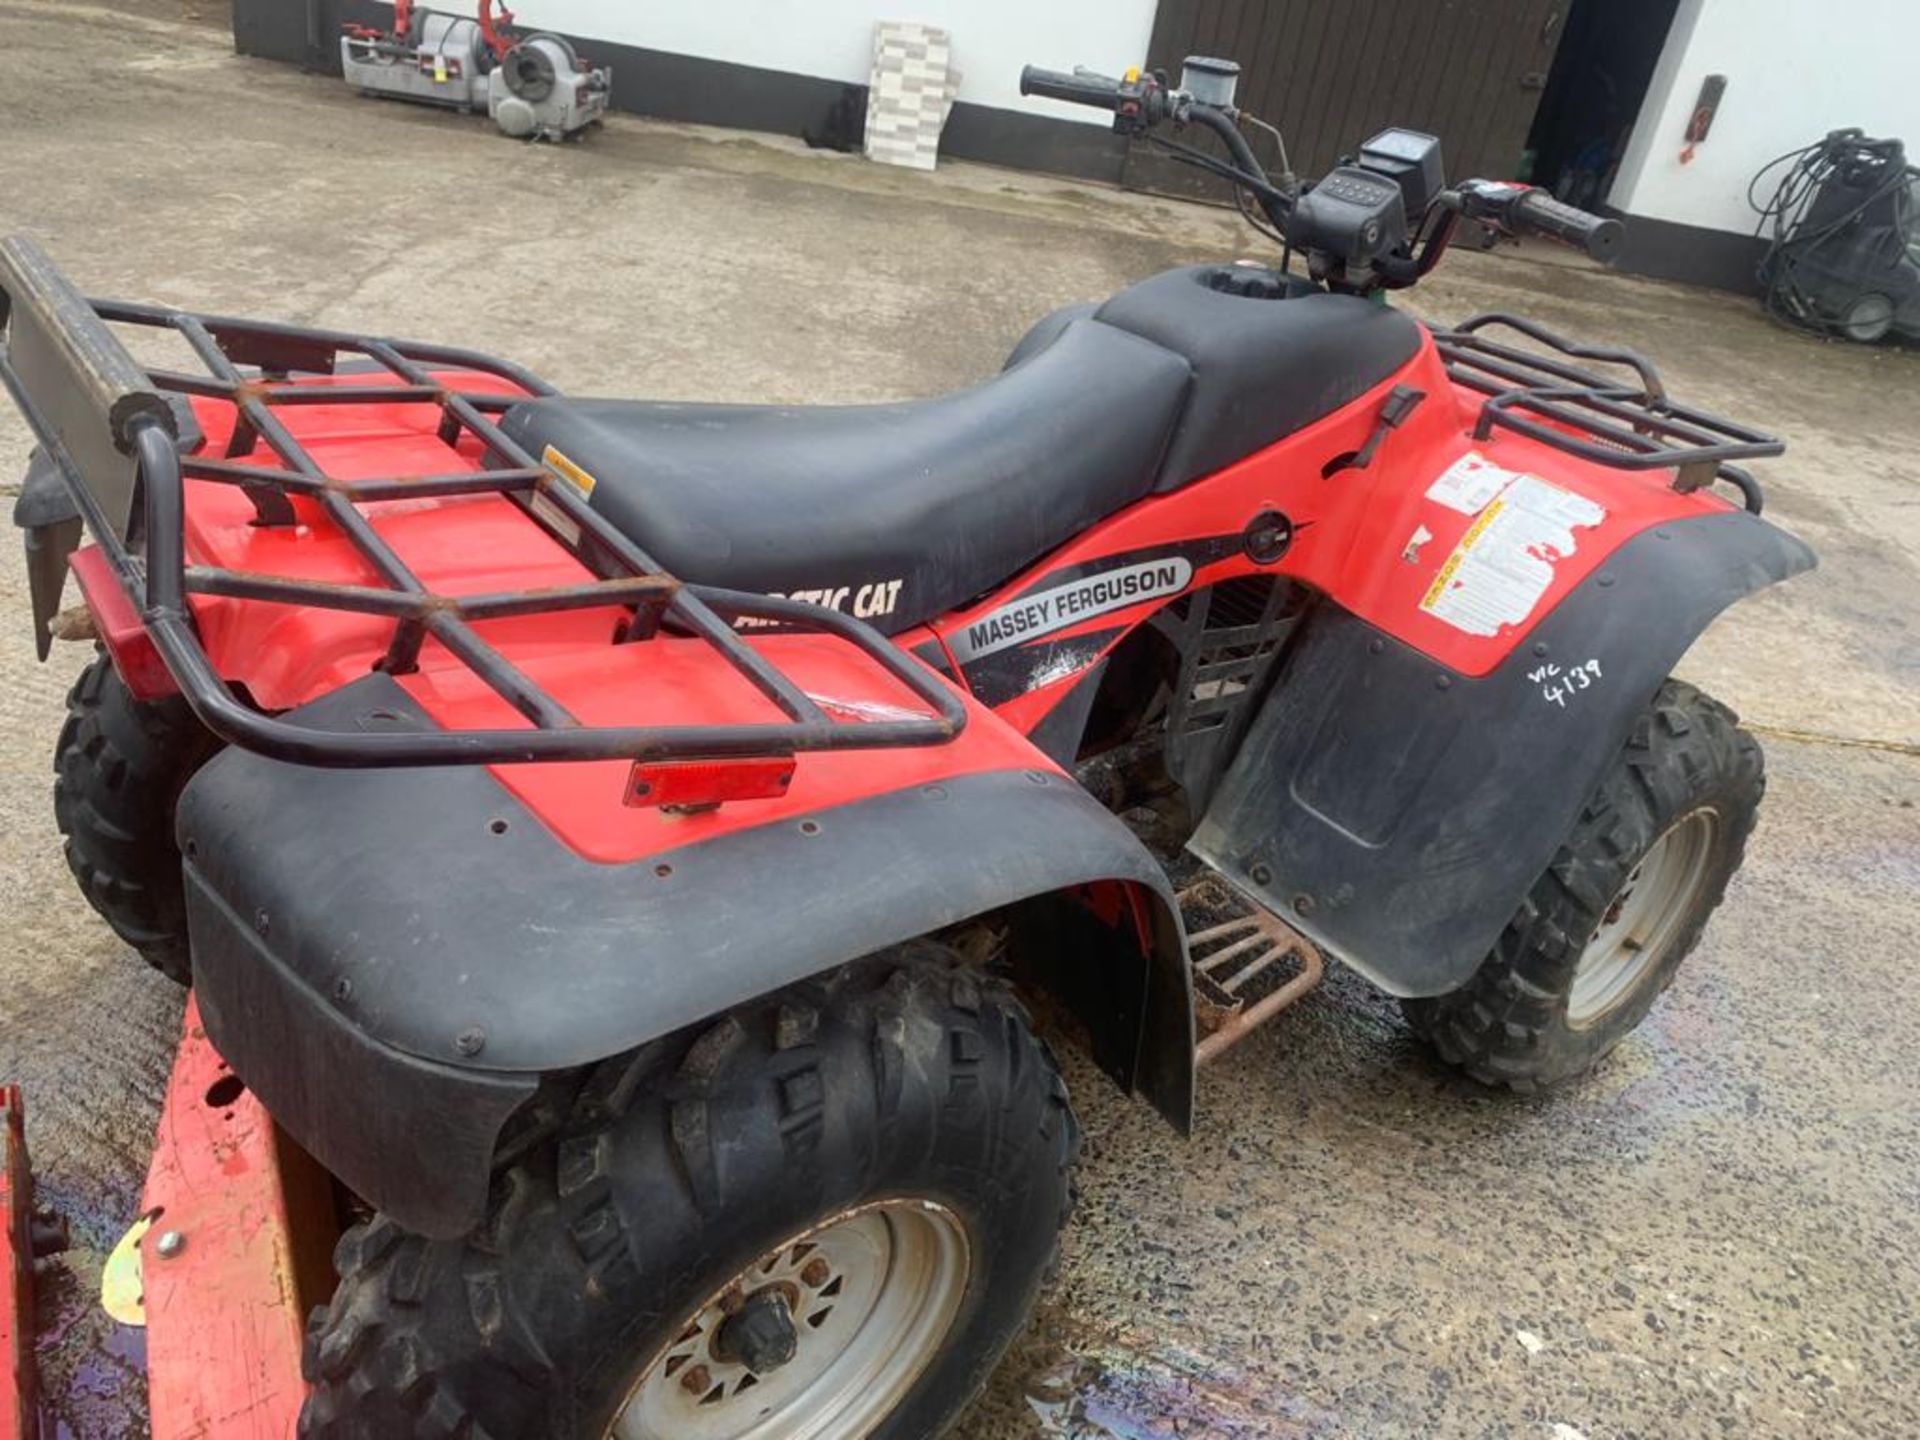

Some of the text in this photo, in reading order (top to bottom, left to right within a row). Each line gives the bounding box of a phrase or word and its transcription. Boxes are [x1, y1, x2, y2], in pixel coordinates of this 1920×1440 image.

[853, 579, 903, 618] CAT
[968, 566, 1177, 650] MASSEY FERGUSON
[1543, 659, 1603, 708] 4139
